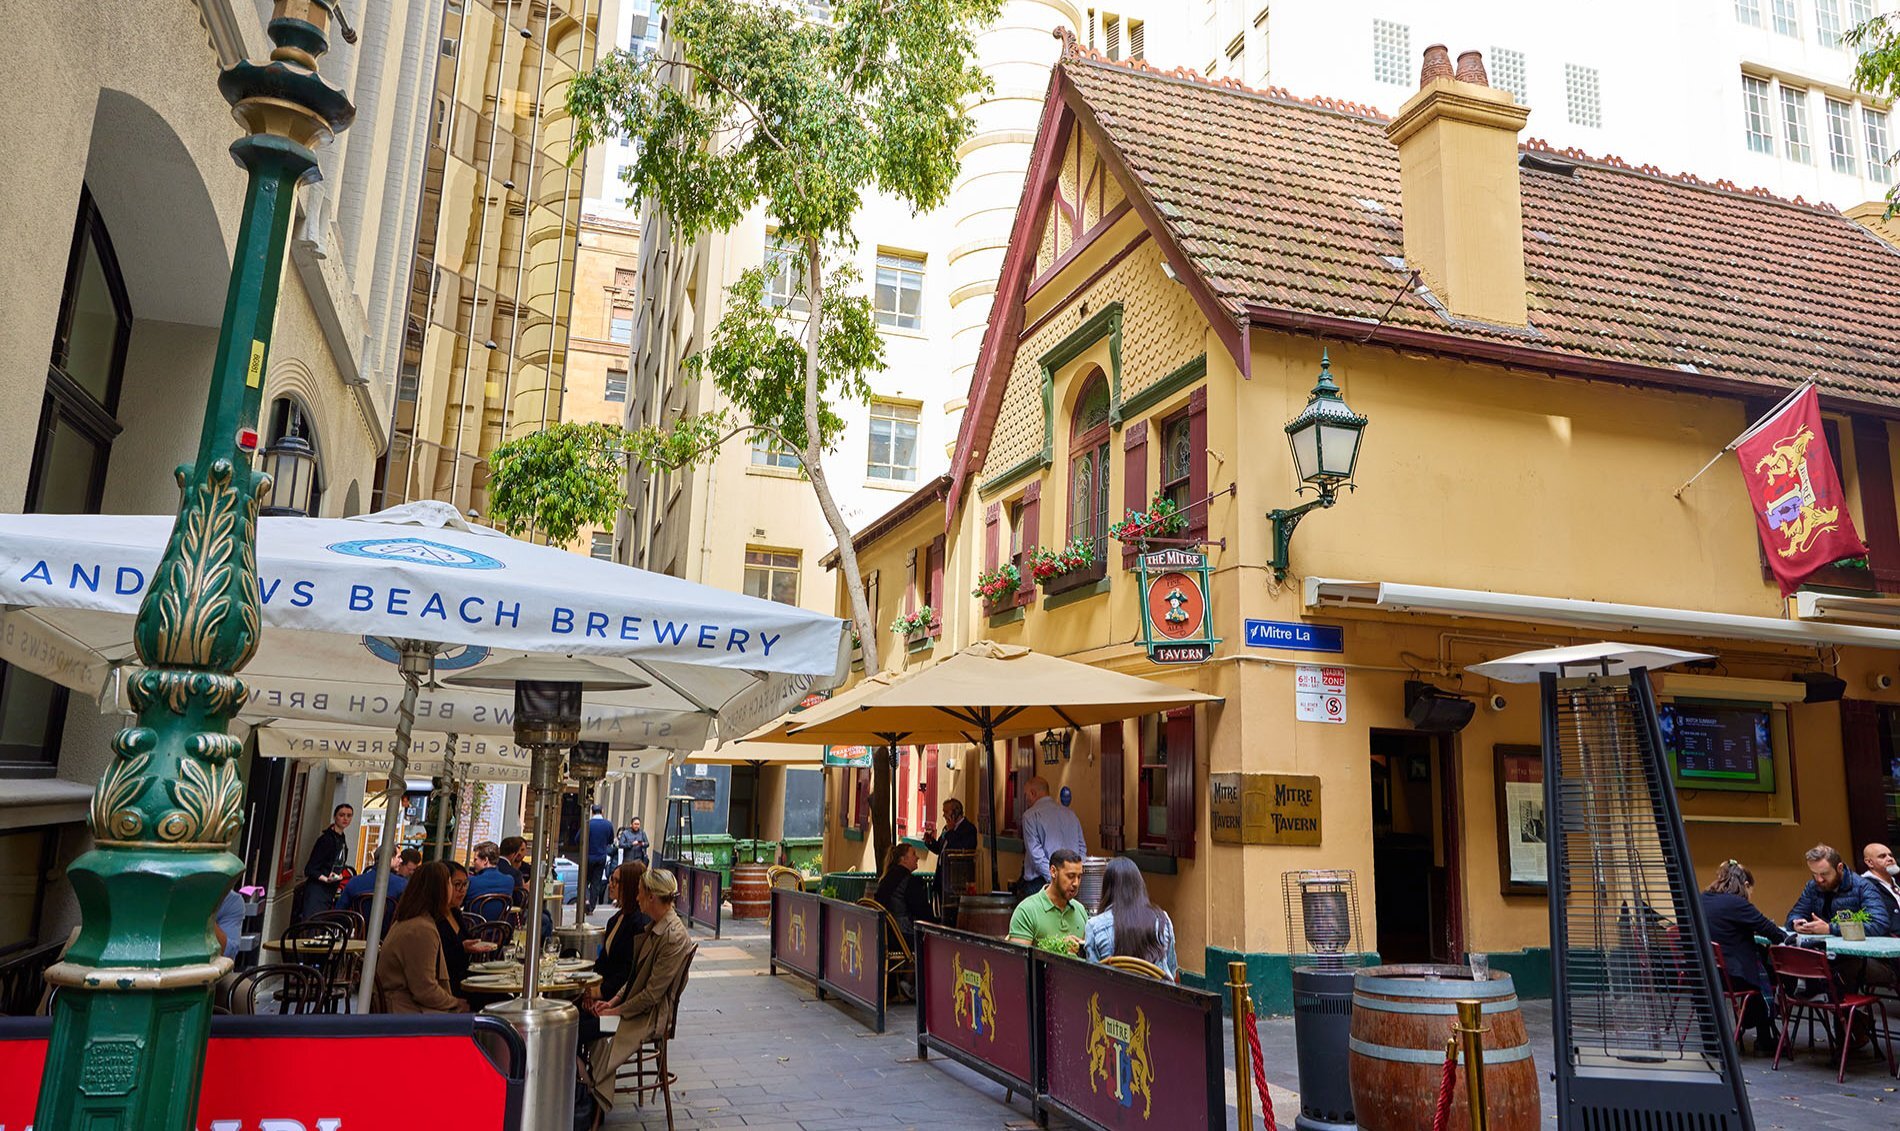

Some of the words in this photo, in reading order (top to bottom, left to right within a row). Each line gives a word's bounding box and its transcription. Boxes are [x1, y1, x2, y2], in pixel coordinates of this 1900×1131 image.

[1147, 553, 1166, 565] THE
[1167, 551, 1199, 565] MITRE
[348, 584, 521, 629] BEACH
[551, 607, 781, 656] BREWERY
[1260, 625, 1292, 640] Mitre
[1296, 628, 1310, 641] La
[1158, 648, 1203, 660] TAVERN
[1323, 668, 1344, 676] LOADING
[1323, 677, 1344, 685] ZONE
[1214, 782, 1237, 804] MITRE
[1273, 784, 1312, 806] MITRE
[1212, 811, 1240, 832] TAVERN
[1271, 813, 1317, 833] TAVERN
[1107, 1021, 1128, 1040] MITRE
